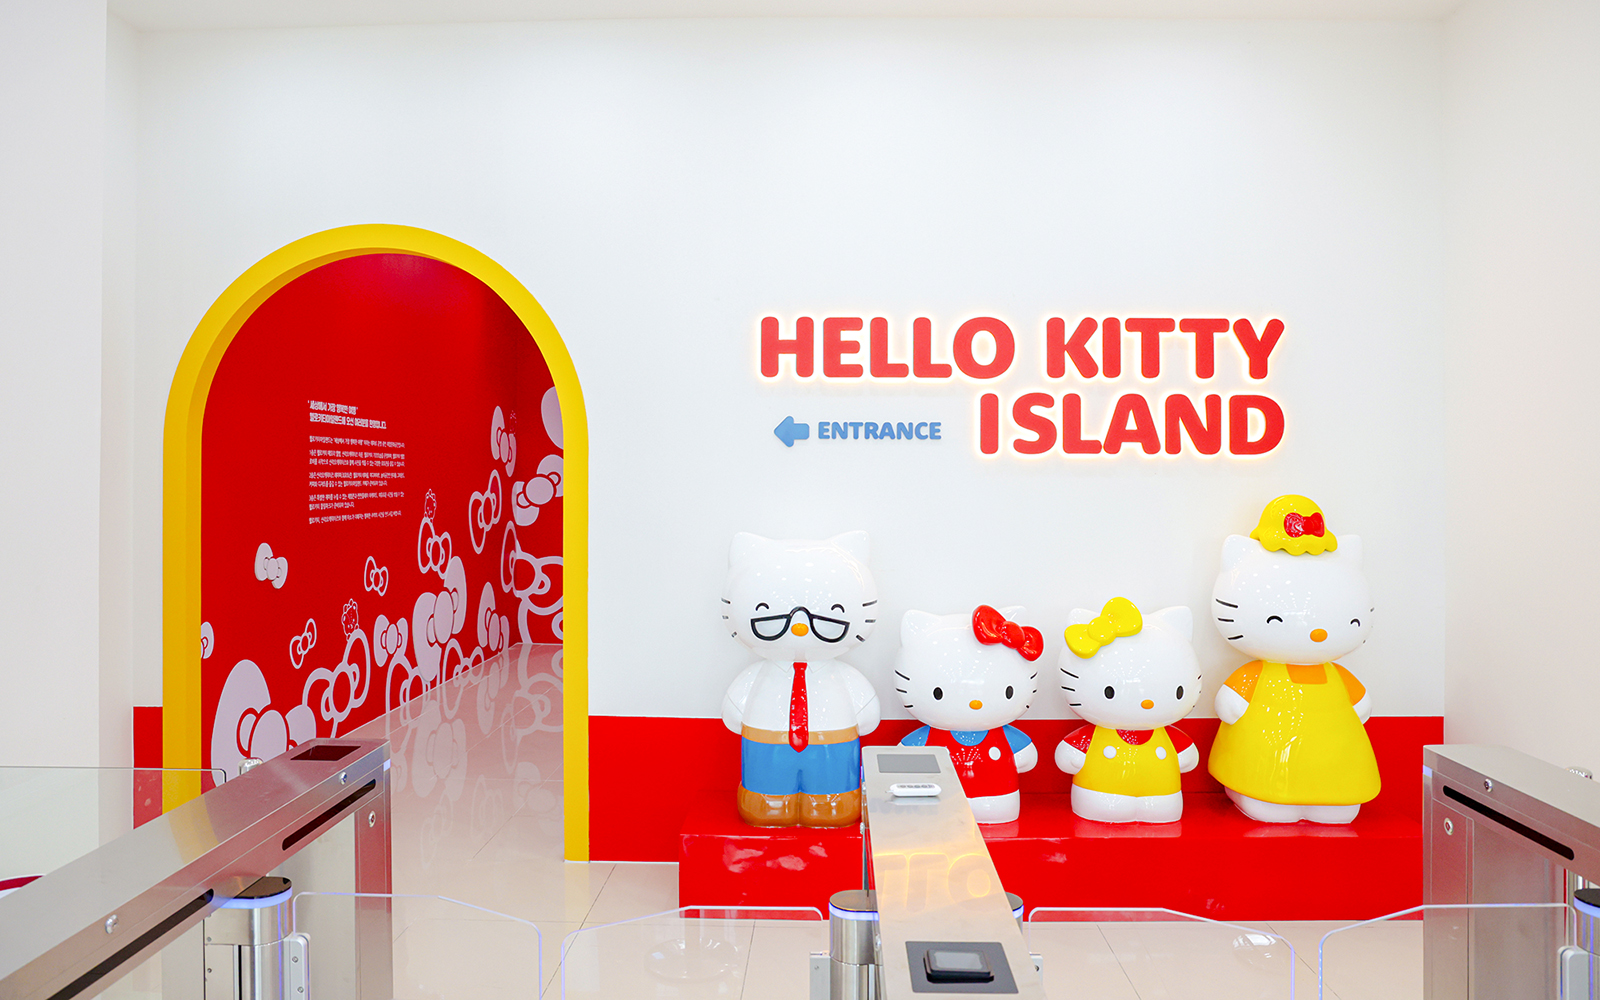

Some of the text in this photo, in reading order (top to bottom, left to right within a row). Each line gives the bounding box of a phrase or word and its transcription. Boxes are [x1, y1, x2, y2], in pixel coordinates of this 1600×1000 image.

[760, 316, 1285, 380] HELLO KITTY
[817, 421, 942, 441] ENTRANCE
[980, 392, 1285, 455] ISLAND
